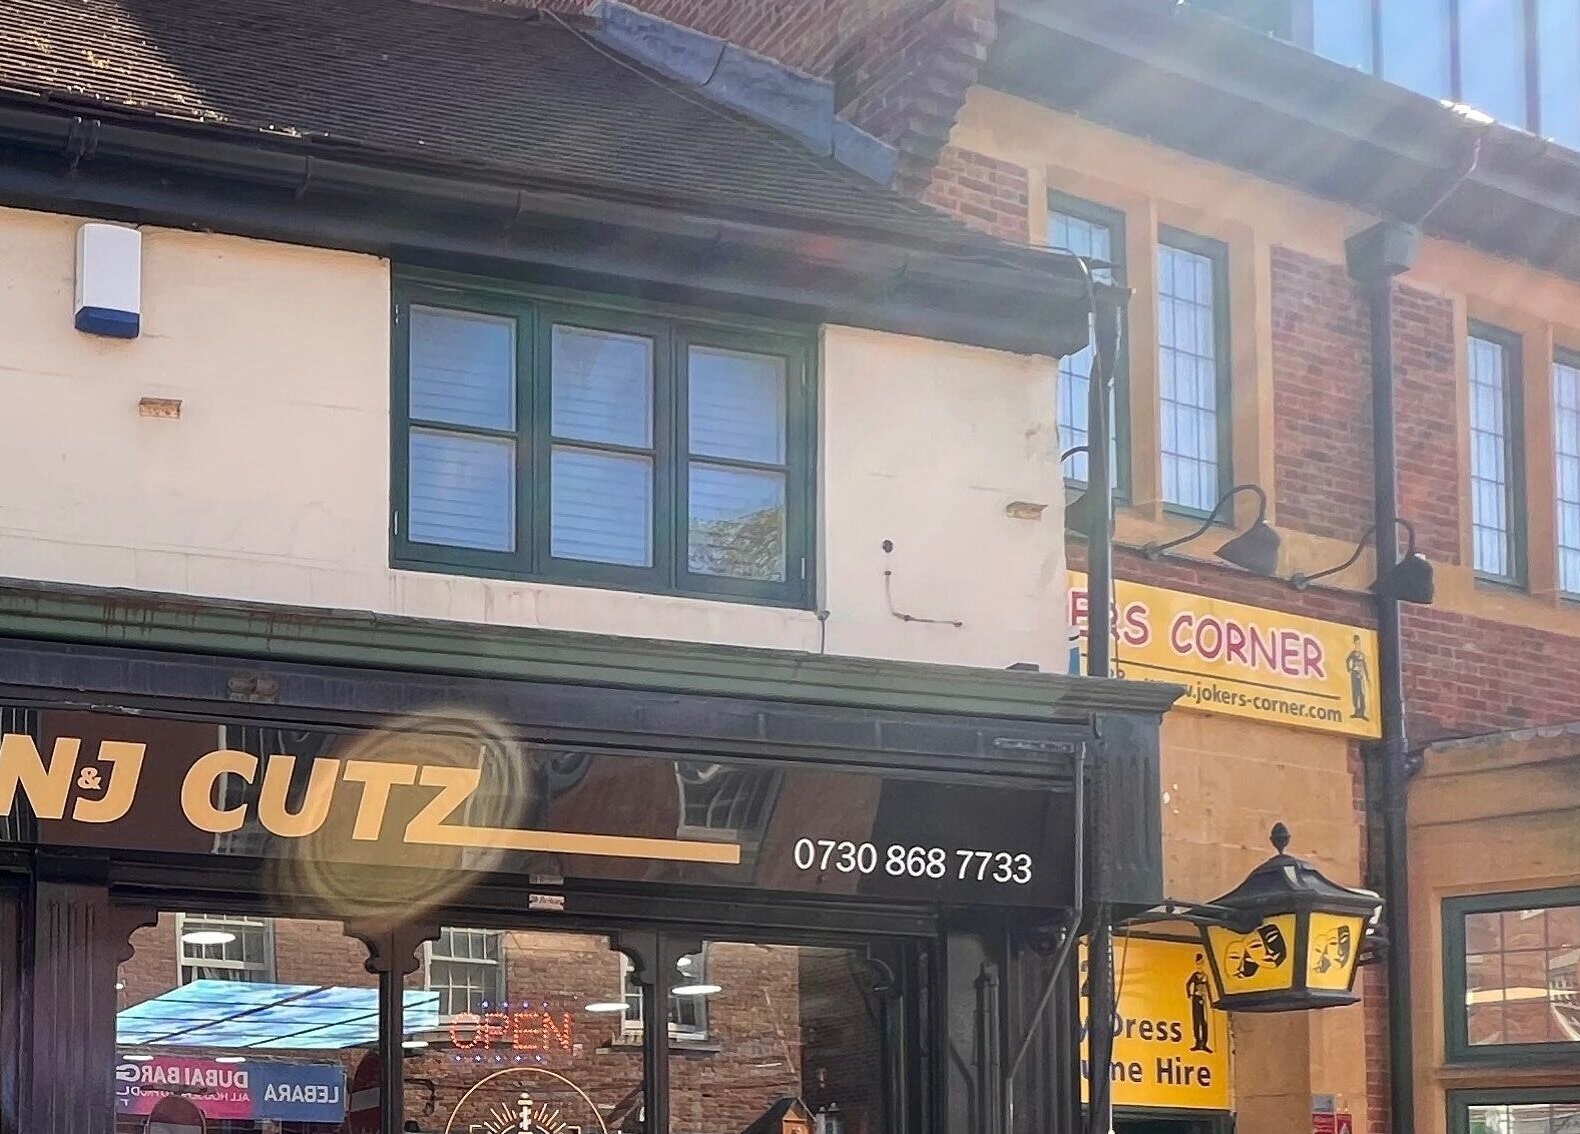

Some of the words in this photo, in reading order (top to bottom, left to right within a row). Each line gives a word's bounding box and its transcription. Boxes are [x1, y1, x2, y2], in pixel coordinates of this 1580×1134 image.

[1171, 615, 1325, 678] CORNER
[180, 749, 482, 847] CUTZ
[794, 838, 878, 874] 0730
[885, 845, 947, 878] 868
[956, 850, 1032, 884] 7733
[449, 1012, 571, 1050] OPEN
[1156, 1056, 1211, 1087] Hire
